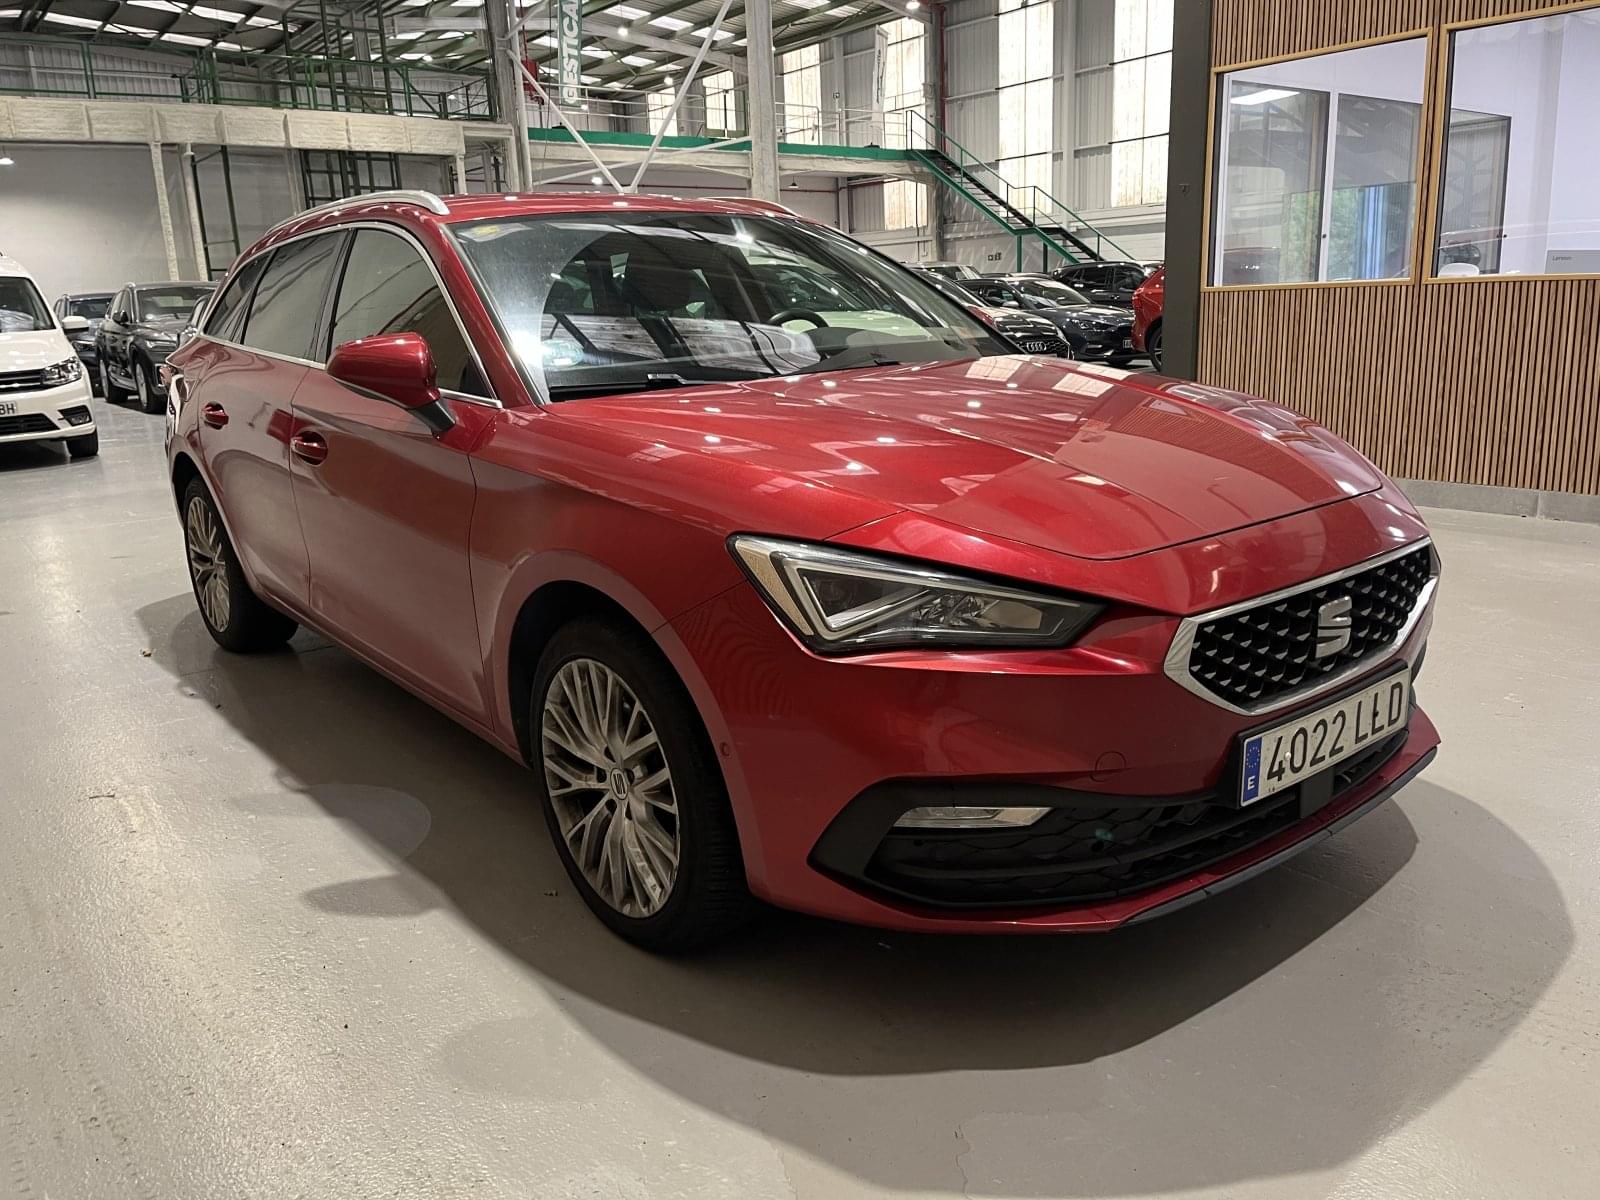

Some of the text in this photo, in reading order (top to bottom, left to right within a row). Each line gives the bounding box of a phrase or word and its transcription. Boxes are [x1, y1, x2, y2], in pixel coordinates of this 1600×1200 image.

[563, 0, 579, 104] GESTICA
[1267, 709, 1347, 781] 4022
[1247, 775, 1256, 790] E
